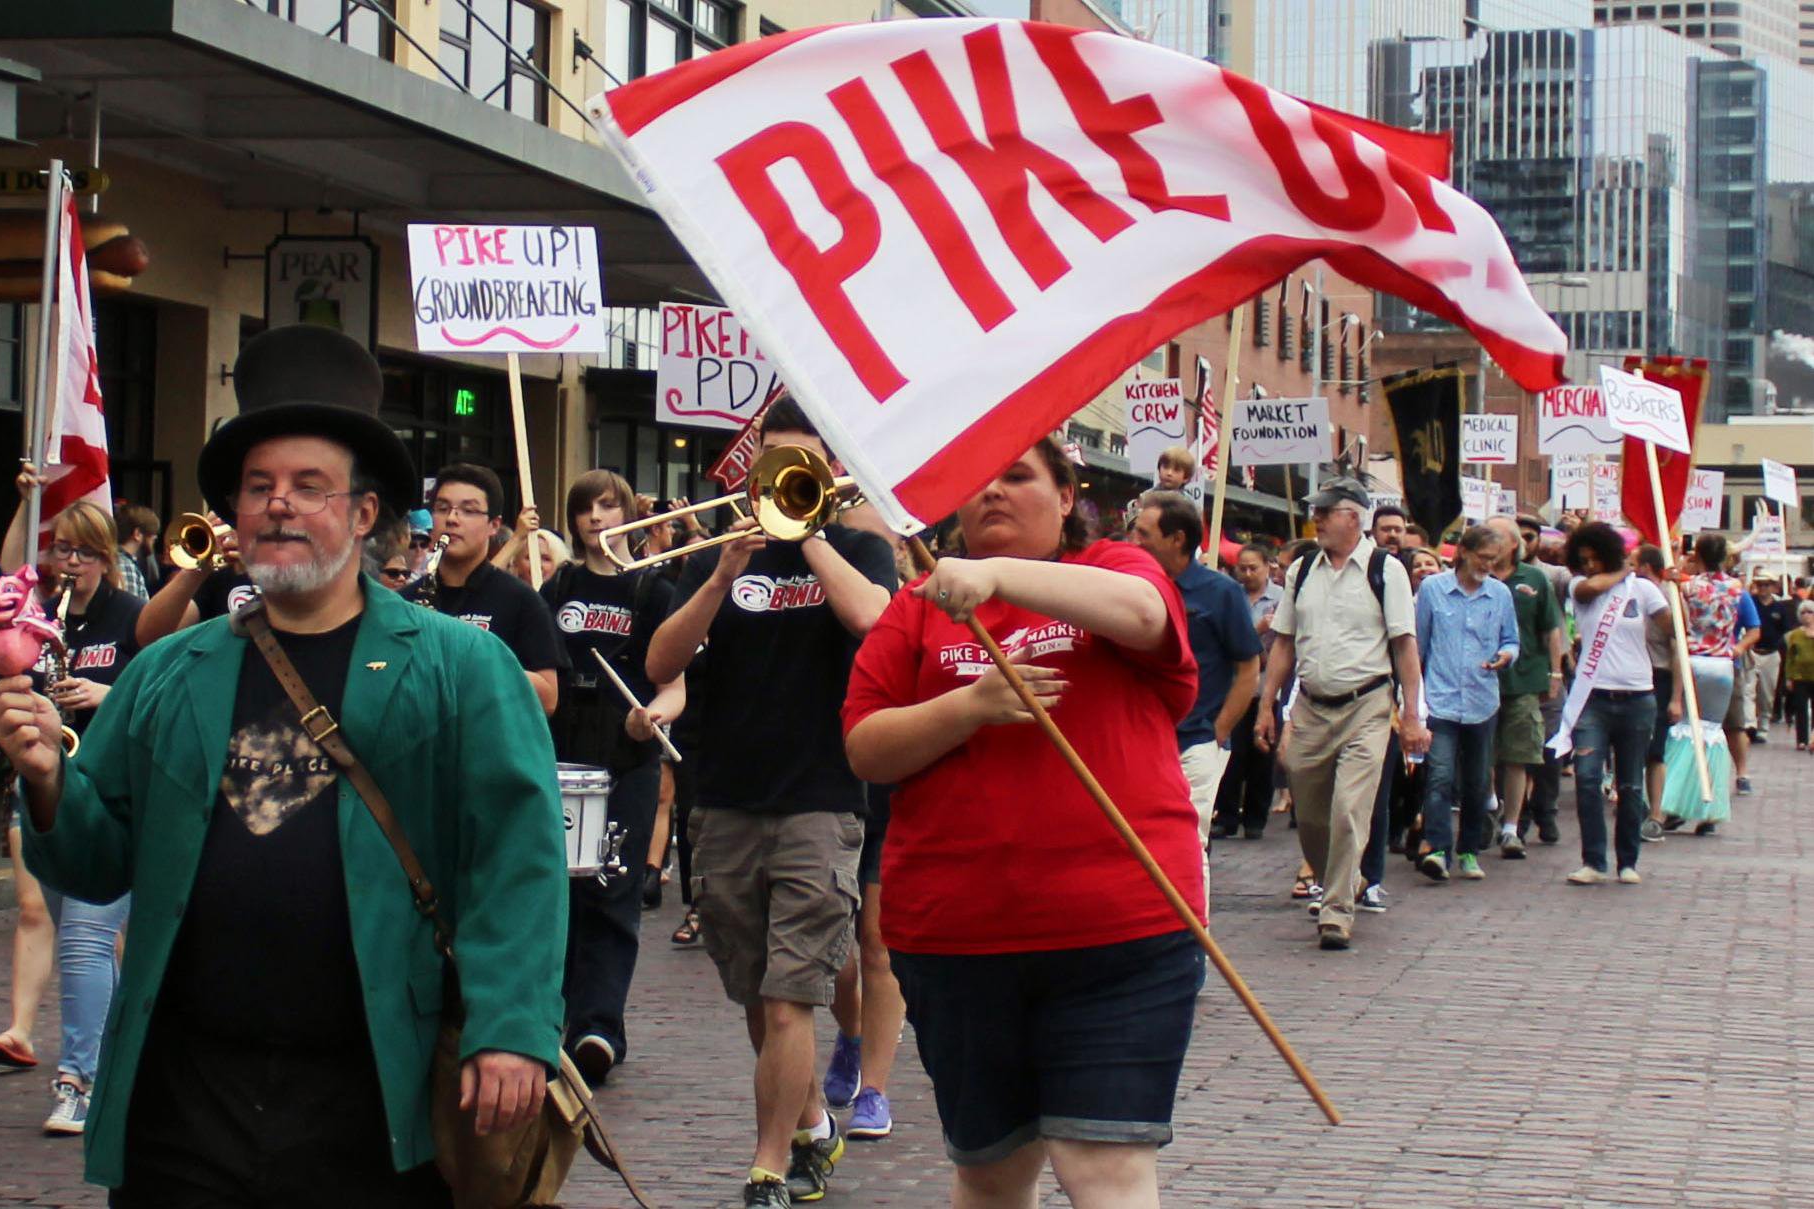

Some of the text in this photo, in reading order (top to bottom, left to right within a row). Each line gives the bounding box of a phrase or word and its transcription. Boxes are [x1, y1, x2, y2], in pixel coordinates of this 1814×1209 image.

[16, 170, 90, 190] DOS
[715, 22, 1231, 404] PIKE
[434, 225, 582, 271] PIKE UP!
[279, 252, 360, 282] PEAR
[415, 275, 597, 325] GROUNDBREAKING
[1125, 382, 1180, 400] KITCHEN
[1543, 388, 1606, 417] MERCHA
[1131, 403, 1179, 424] CREW
[1246, 403, 1309, 423] MARKET
[1232, 425, 1318, 441] FOUNDATION
[1463, 418, 1513, 433] MEDICAL
[1463, 438, 1507, 454] CLINIC
[768, 583, 826, 611] BAND
[584, 610, 633, 636] BAND
[940, 648, 973, 664] PIKE
[272, 757, 328, 775] PLCE
